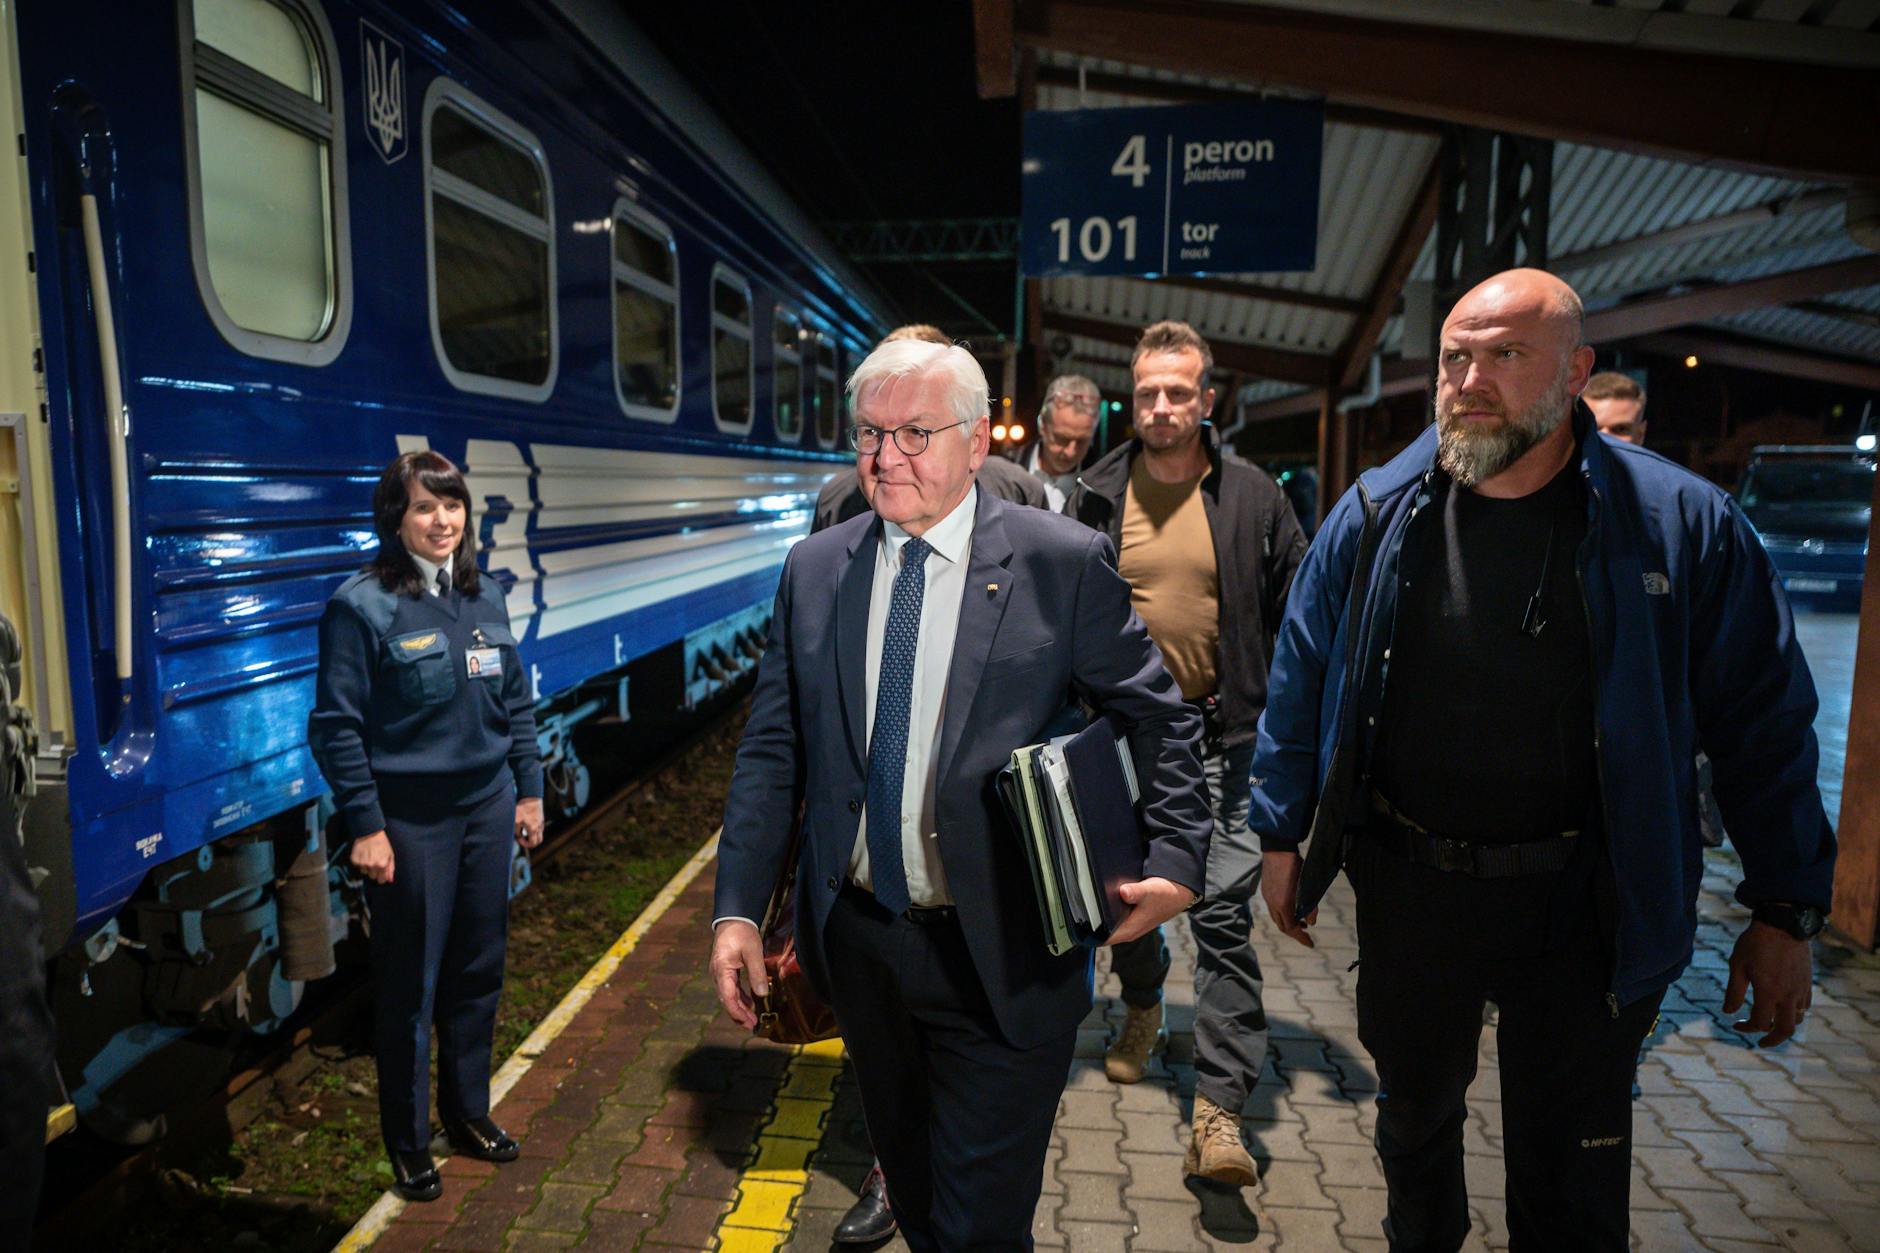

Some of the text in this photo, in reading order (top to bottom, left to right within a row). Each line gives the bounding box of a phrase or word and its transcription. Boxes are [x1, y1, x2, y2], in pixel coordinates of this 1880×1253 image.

[1110, 134, 1151, 188] 4
[1184, 139, 1275, 170] peron
[1183, 166, 1246, 185] platform
[1050, 215, 1138, 263] 101
[1182, 221, 1220, 243] tor
